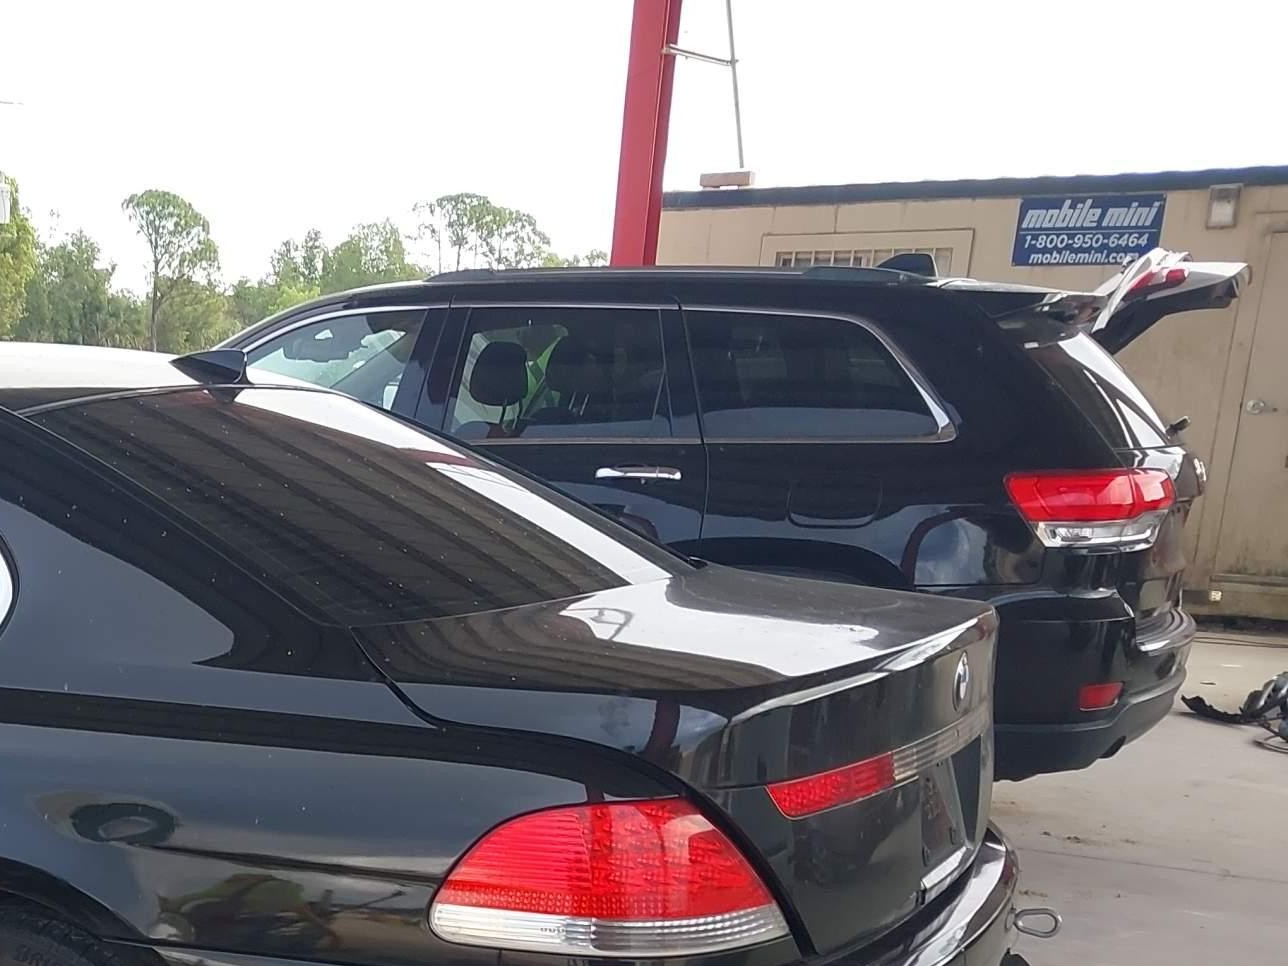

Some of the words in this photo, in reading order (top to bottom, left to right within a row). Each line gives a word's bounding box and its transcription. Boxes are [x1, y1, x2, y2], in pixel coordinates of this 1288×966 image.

[1022, 199, 1102, 228] mobile
[1102, 201, 1161, 227] mini
[1024, 233, 1149, 249] 1-800-950-6464
